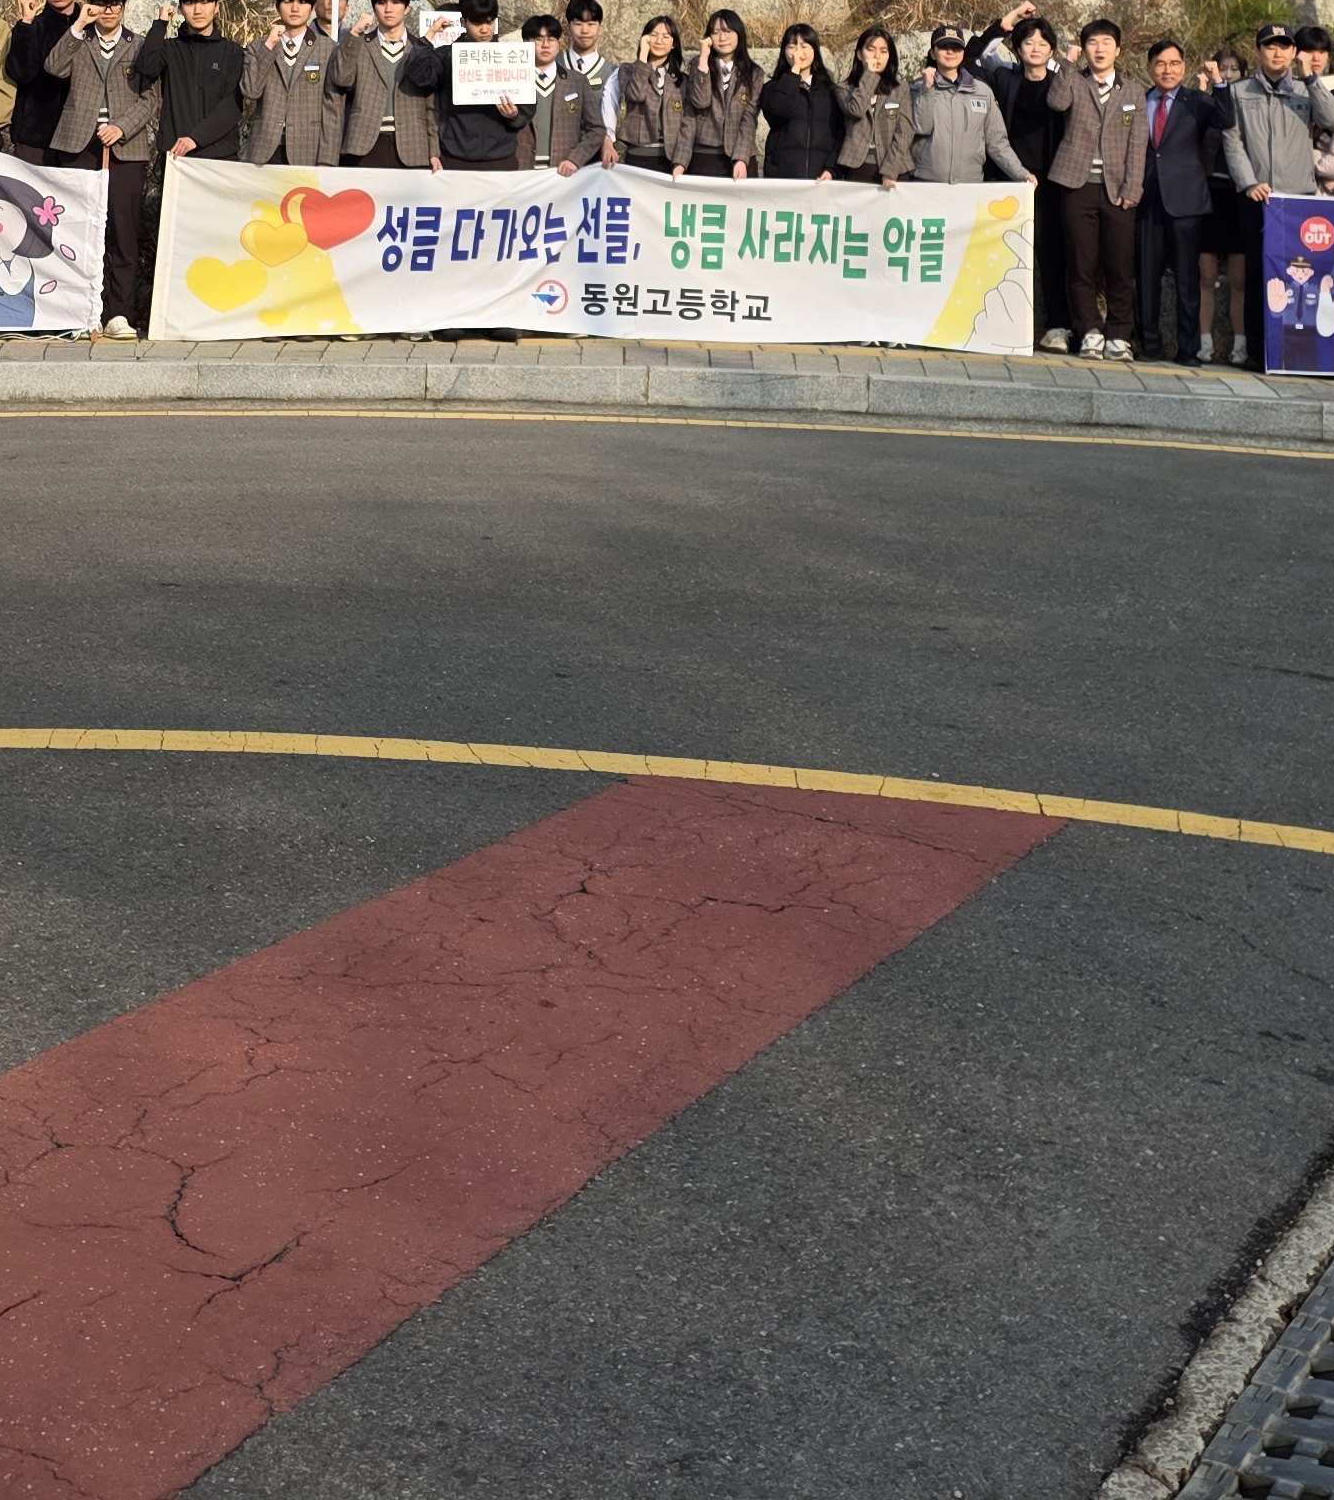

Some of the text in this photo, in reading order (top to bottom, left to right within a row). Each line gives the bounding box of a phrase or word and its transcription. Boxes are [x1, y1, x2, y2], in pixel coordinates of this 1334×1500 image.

[458, 49, 529, 65] 클릭하는 순간
[458, 68, 531, 83] 당신도 공범입니다!
[376, 204, 443, 273] 성큼
[576, 196, 641, 265] 선플,
[664, 201, 727, 271] 냉큼
[737, 207, 869, 280] 사라지는
[882, 217, 946, 283] 악플
[1304, 232, 1332, 245] OUT
[581, 283, 773, 323] 동원고등학교
